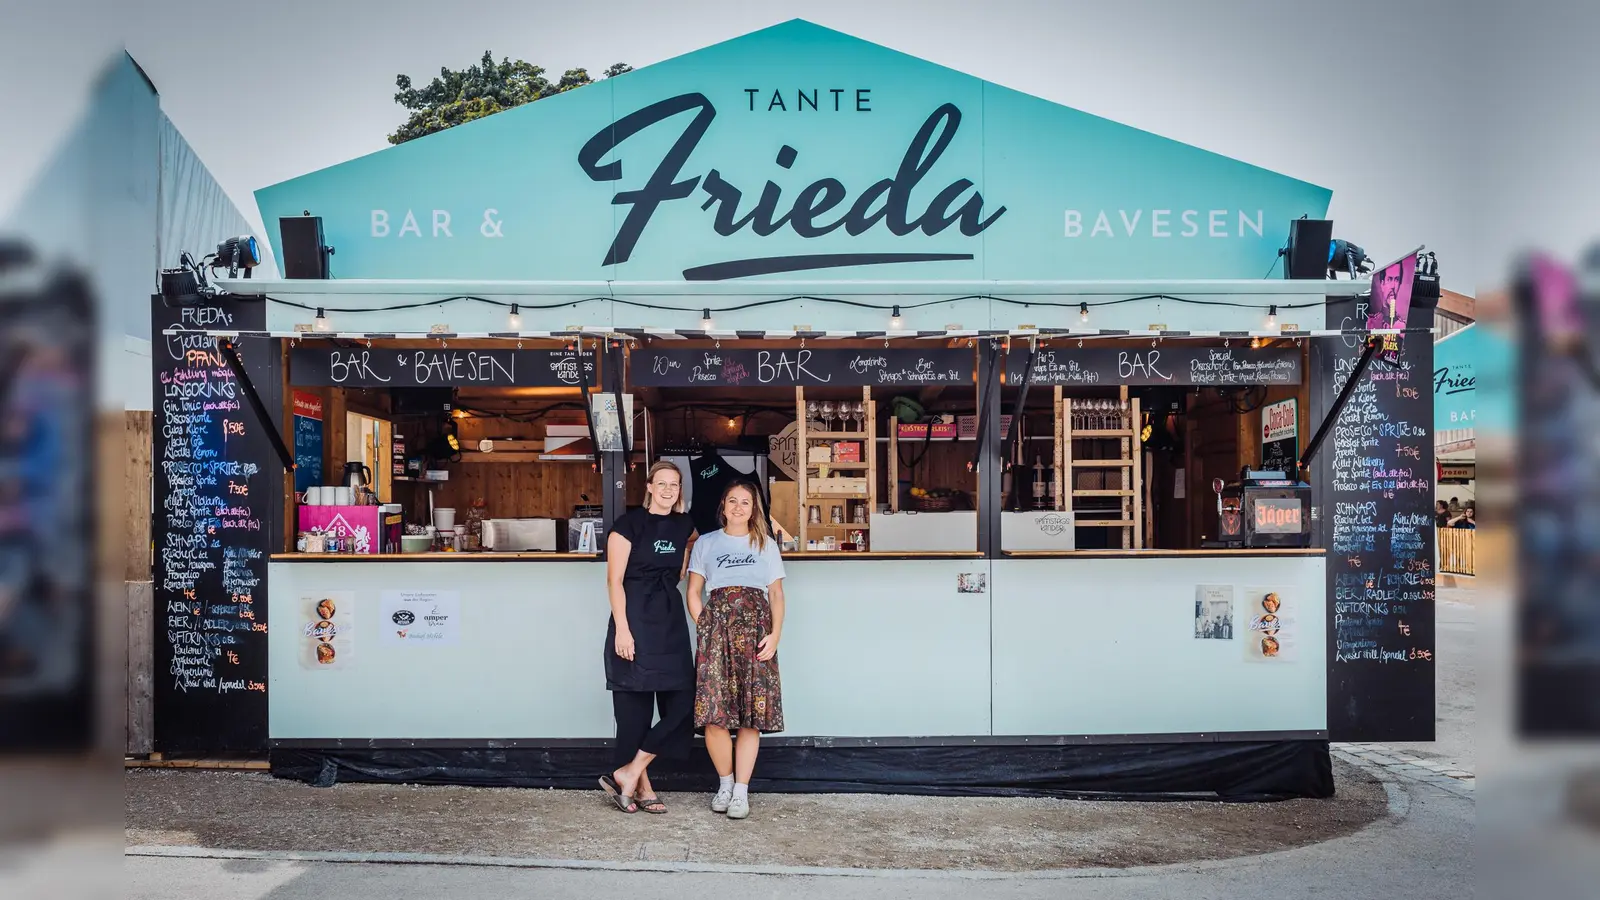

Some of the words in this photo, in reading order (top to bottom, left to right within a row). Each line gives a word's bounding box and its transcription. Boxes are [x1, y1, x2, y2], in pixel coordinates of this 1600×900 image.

[744, 89, 872, 111] TANTE
[578, 92, 1007, 266] Frieda
[371, 209, 453, 237] BAR
[480, 208, 504, 237] &
[1064, 209, 1264, 237] BAVESEN
[331, 351, 391, 382] BAR
[397, 354, 408, 366] &
[415, 351, 515, 383] BAVESEN
[757, 351, 831, 383] BAR
[1118, 351, 1172, 379] BAR
[1270, 404, 1294, 430] Coca-Cola
[1335, 425, 1372, 440] PROSECCO
[1257, 505, 1299, 526] Jäger
[1335, 501, 1377, 516] SCHNAPS
[166, 533, 207, 549] SCHNAPS
[654, 540, 676, 553] Frieda
[717, 554, 757, 568] Frieda
[1335, 602, 1389, 616] SOFTDRINKS
